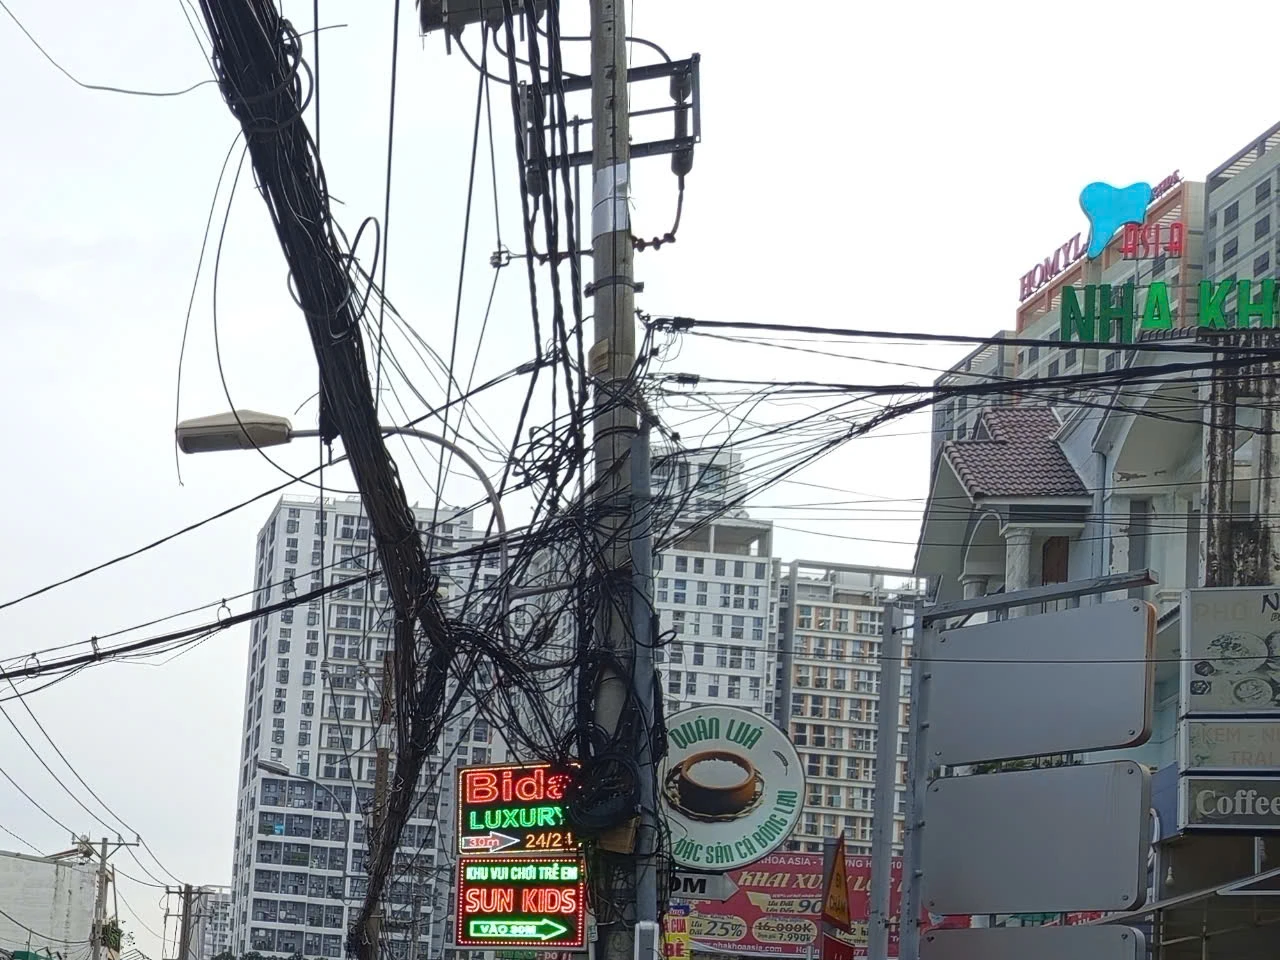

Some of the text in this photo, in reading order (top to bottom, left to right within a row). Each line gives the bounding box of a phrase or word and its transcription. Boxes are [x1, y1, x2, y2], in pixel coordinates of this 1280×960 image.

[1122, 222, 1184, 259] ASIA
[1019, 232, 1089, 302] HOMYL
[1198, 278, 1280, 329] KH
[668, 715, 720, 750] QUÁN
[1195, 789, 1280, 815] Coffee
[673, 838, 703, 862] ĐẶC
[705, 841, 735, 864] SẢN
[735, 835, 757, 859] CÁ
[773, 790, 799, 815] LAU
[469, 838, 500, 847] 30m
[466, 866, 489, 880] KHU
[490, 866, 509, 880] VUI
[560, 866, 578, 880] EM
[787, 857, 811, 866] ASIA
[738, 870, 790, 889] KHAI
[465, 888, 576, 913] SUN KIDS
[704, 921, 744, 937] 25%
